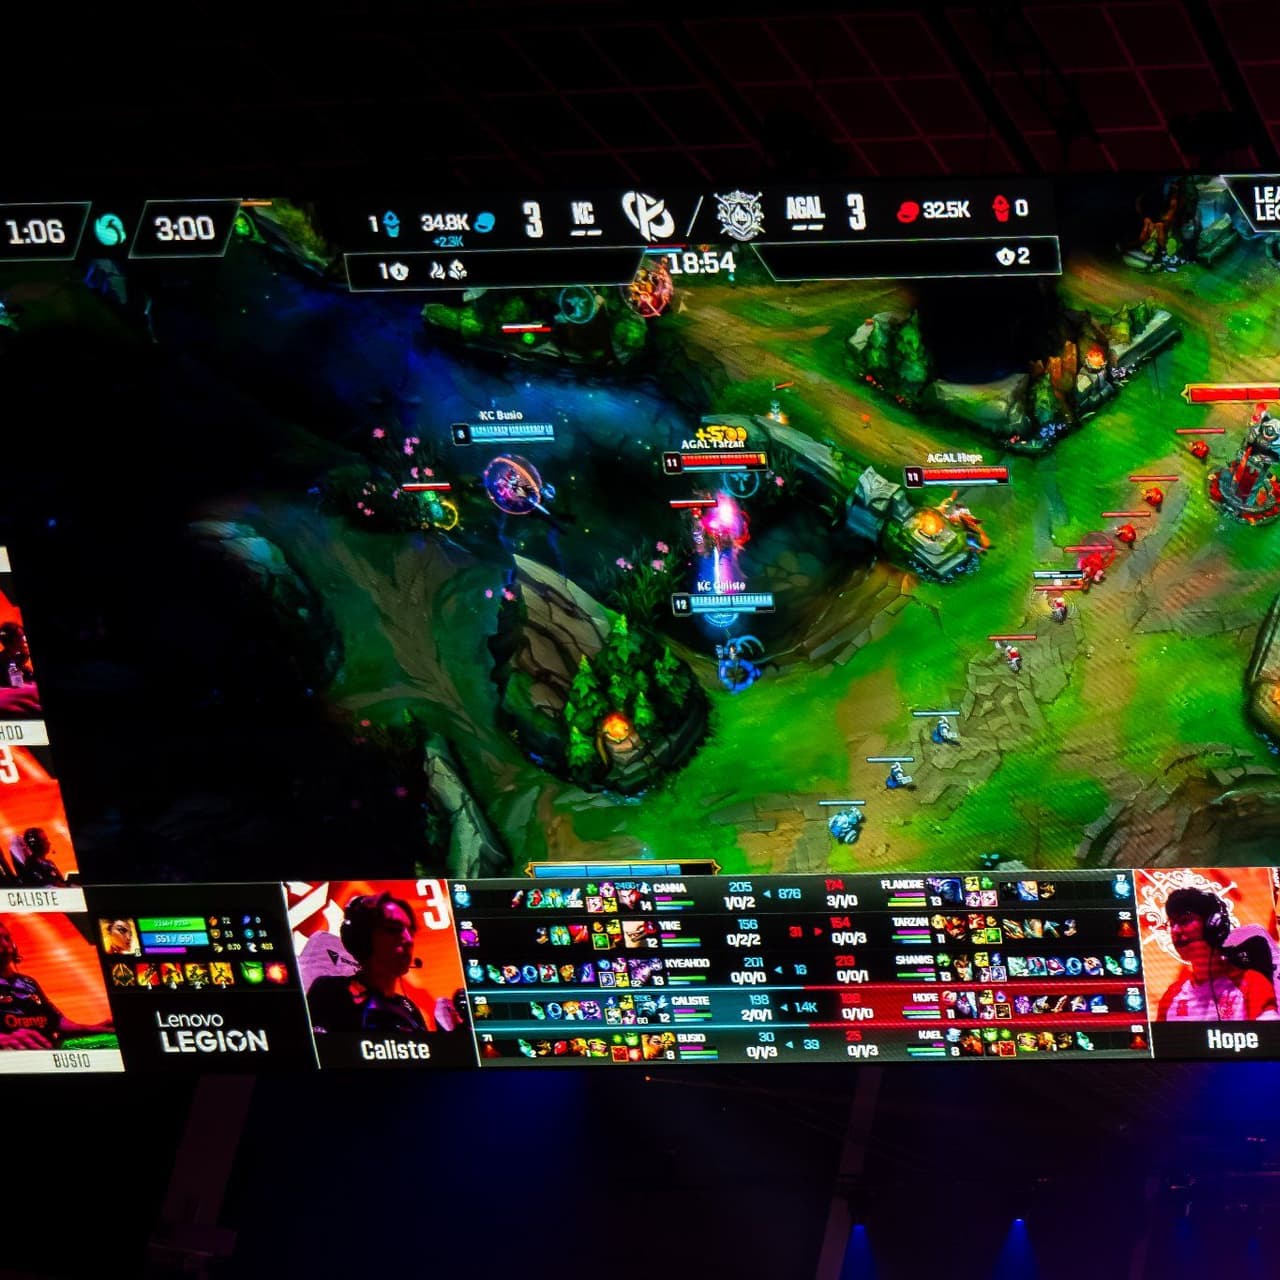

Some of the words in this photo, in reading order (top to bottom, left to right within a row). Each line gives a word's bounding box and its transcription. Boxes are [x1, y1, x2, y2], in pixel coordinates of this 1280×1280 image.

[572, 201, 596, 225] KC
[786, 196, 825, 221] AGAL
[847, 193, 867, 231] 3
[922, 201, 972, 219] 32.5K
[1015, 199, 1029, 217] 0
[154, 215, 216, 242] 3:00
[368, 215, 379, 233] 1
[421, 213, 470, 231] 34.8K
[523, 202, 543, 237] 3
[5, 219, 66, 245] 1:06
[667, 251, 736, 276] 18:54
[1018, 247, 1031, 264] 2
[8, 891, 59, 907] CALISTE
[416, 879, 452, 930] 3
[156, 1010, 223, 1028] Lenovo
[160, 1030, 269, 1052] LEGION
[1208, 1029, 1259, 1049] Hope
[53, 1053, 91, 1068] BUSIO
[360, 1040, 431, 1060] Caliste
